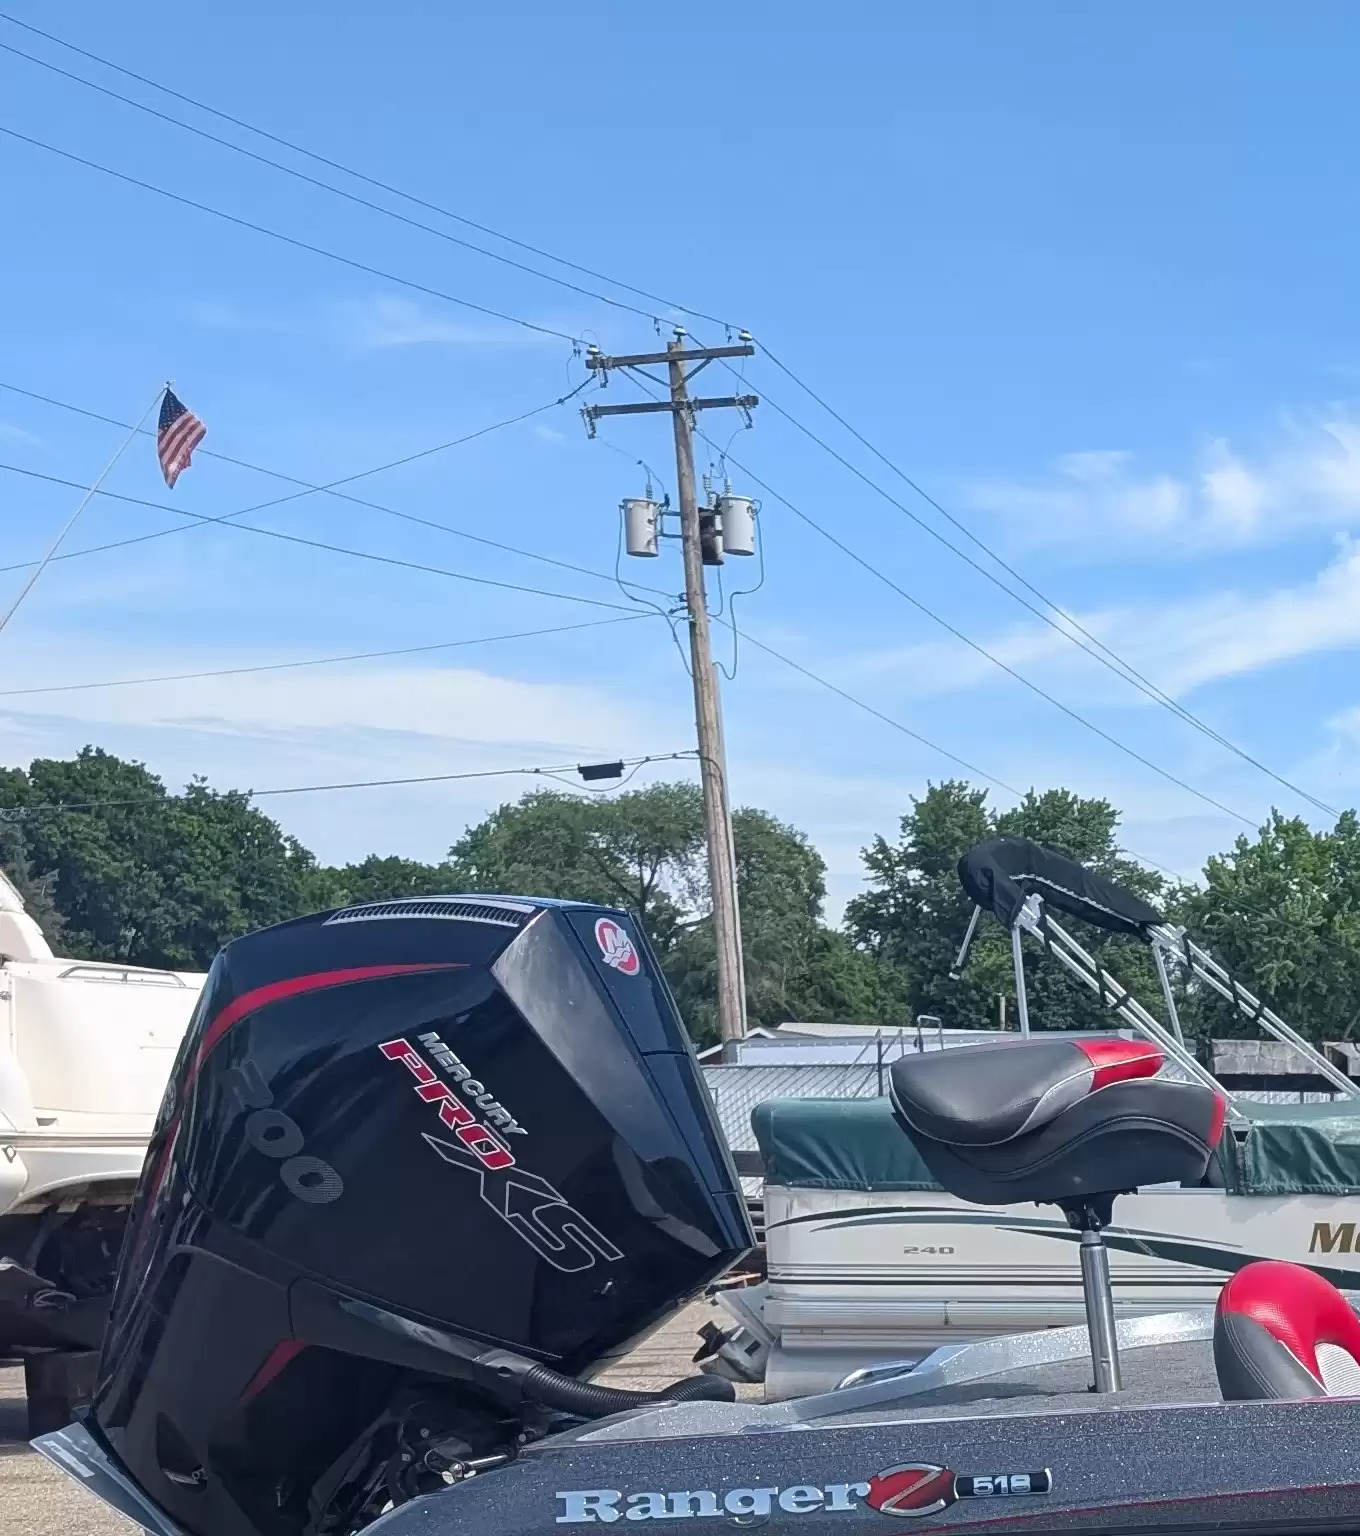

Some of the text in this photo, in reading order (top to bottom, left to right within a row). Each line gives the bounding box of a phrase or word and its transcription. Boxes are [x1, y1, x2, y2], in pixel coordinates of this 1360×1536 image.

[417, 1031, 529, 1136] MERCURY
[377, 1037, 625, 1273] PRO XS
[903, 1246, 955, 1255] 240
[555, 1481, 871, 1528] Ranger
[972, 1474, 1031, 1496] 518
